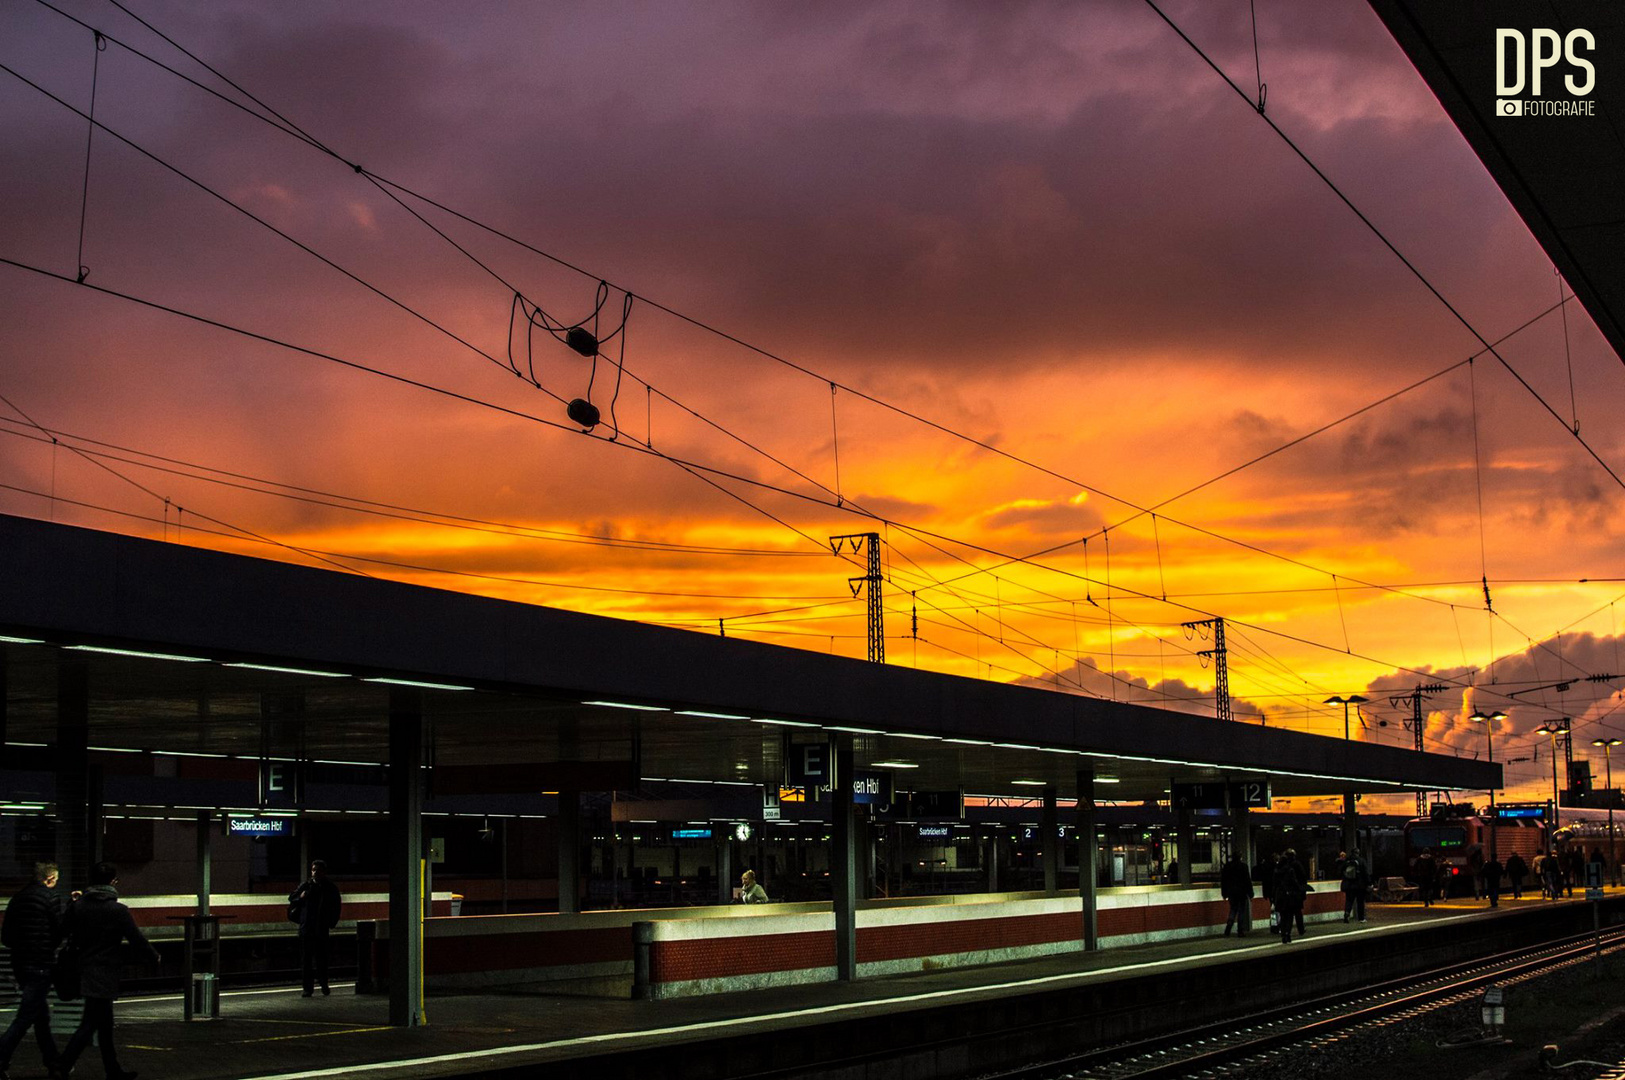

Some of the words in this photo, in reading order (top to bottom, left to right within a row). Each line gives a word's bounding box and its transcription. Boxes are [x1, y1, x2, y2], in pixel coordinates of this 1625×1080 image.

[804, 746, 821, 775] E
[269, 764, 283, 791] E
[867, 778, 880, 794] Hbf
[1193, 785, 1203, 798] 11
[1240, 783, 1261, 802] 12
[231, 819, 270, 831] Saarbrücken
[271, 820, 283, 831] Hbf
[1058, 827, 1065, 837] 3
[1025, 828, 1031, 838] 2
